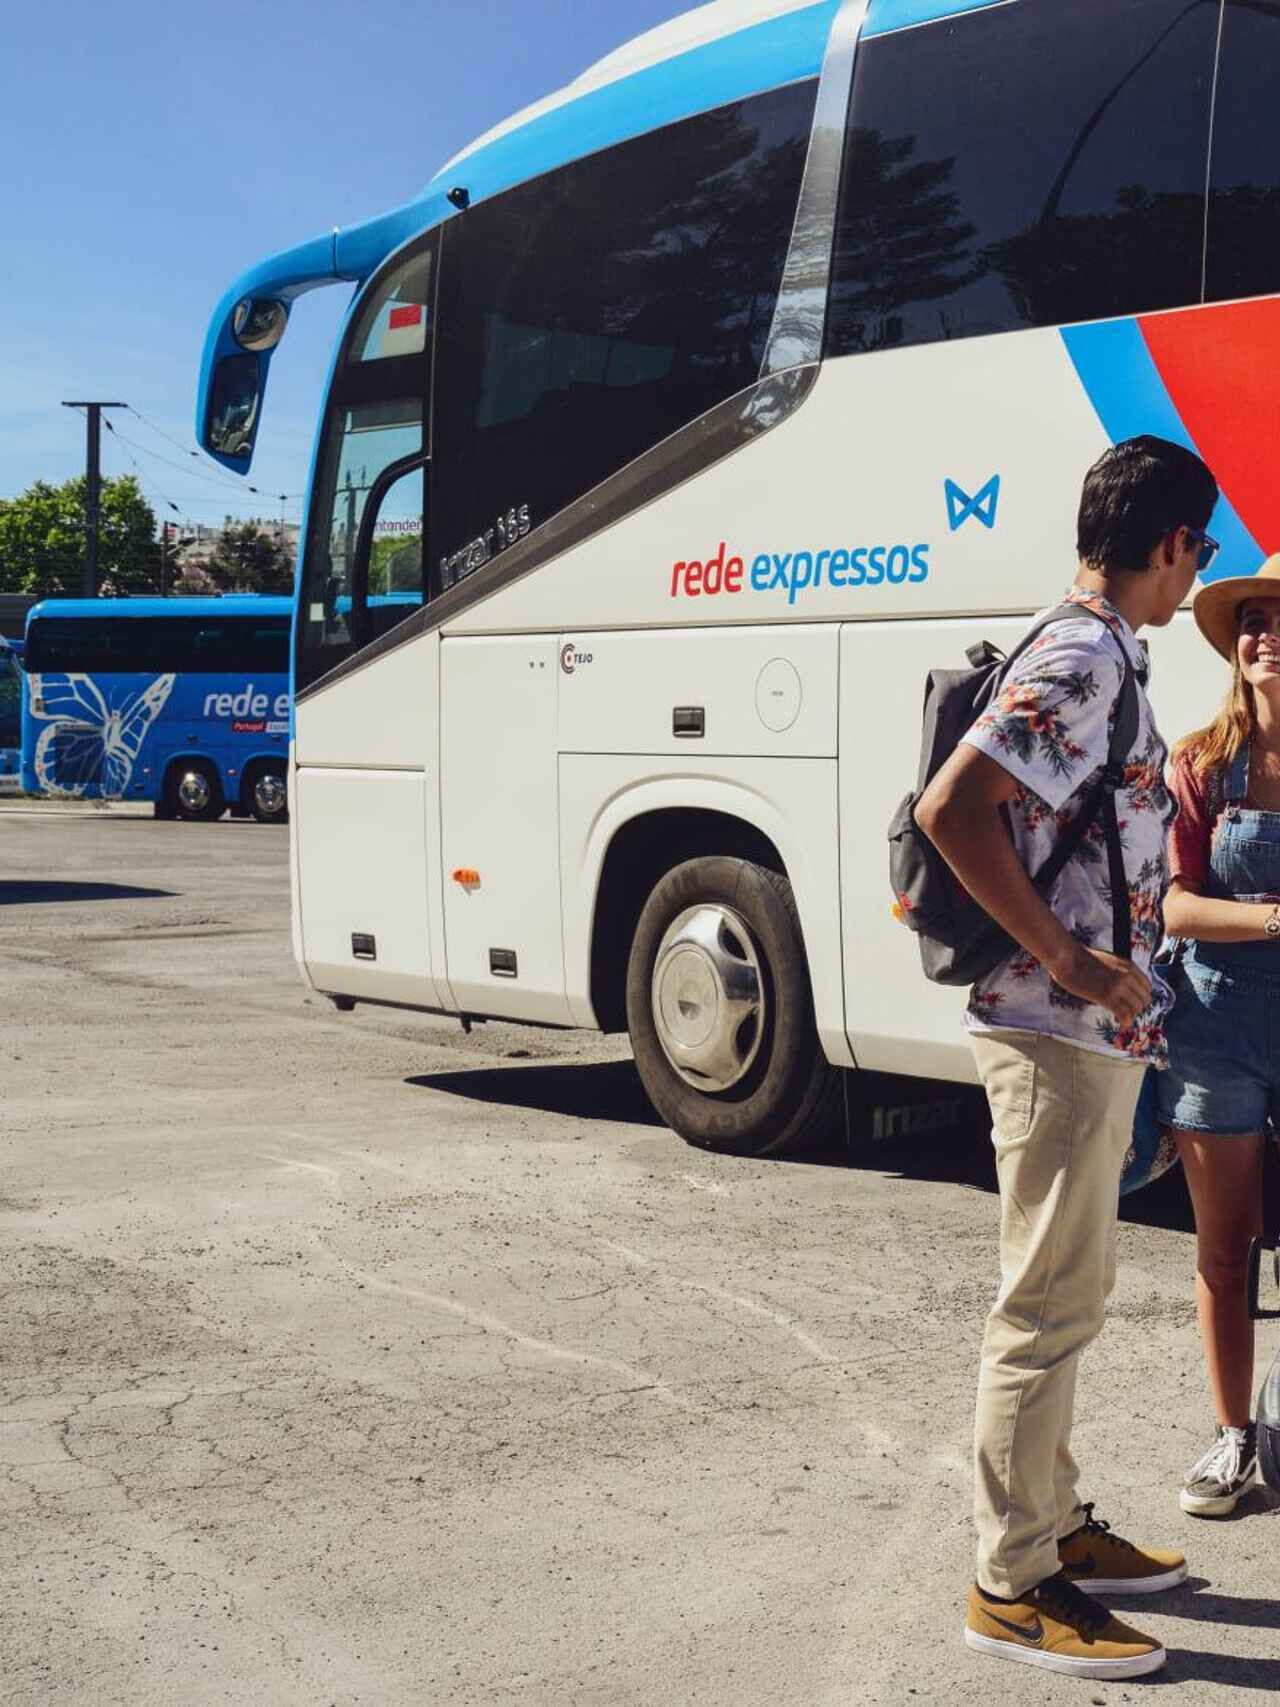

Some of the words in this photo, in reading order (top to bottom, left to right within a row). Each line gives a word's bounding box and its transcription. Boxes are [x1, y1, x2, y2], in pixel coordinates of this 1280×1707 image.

[671, 542, 743, 597] rede
[751, 543, 929, 604] expressos
[203, 683, 268, 717] rede
